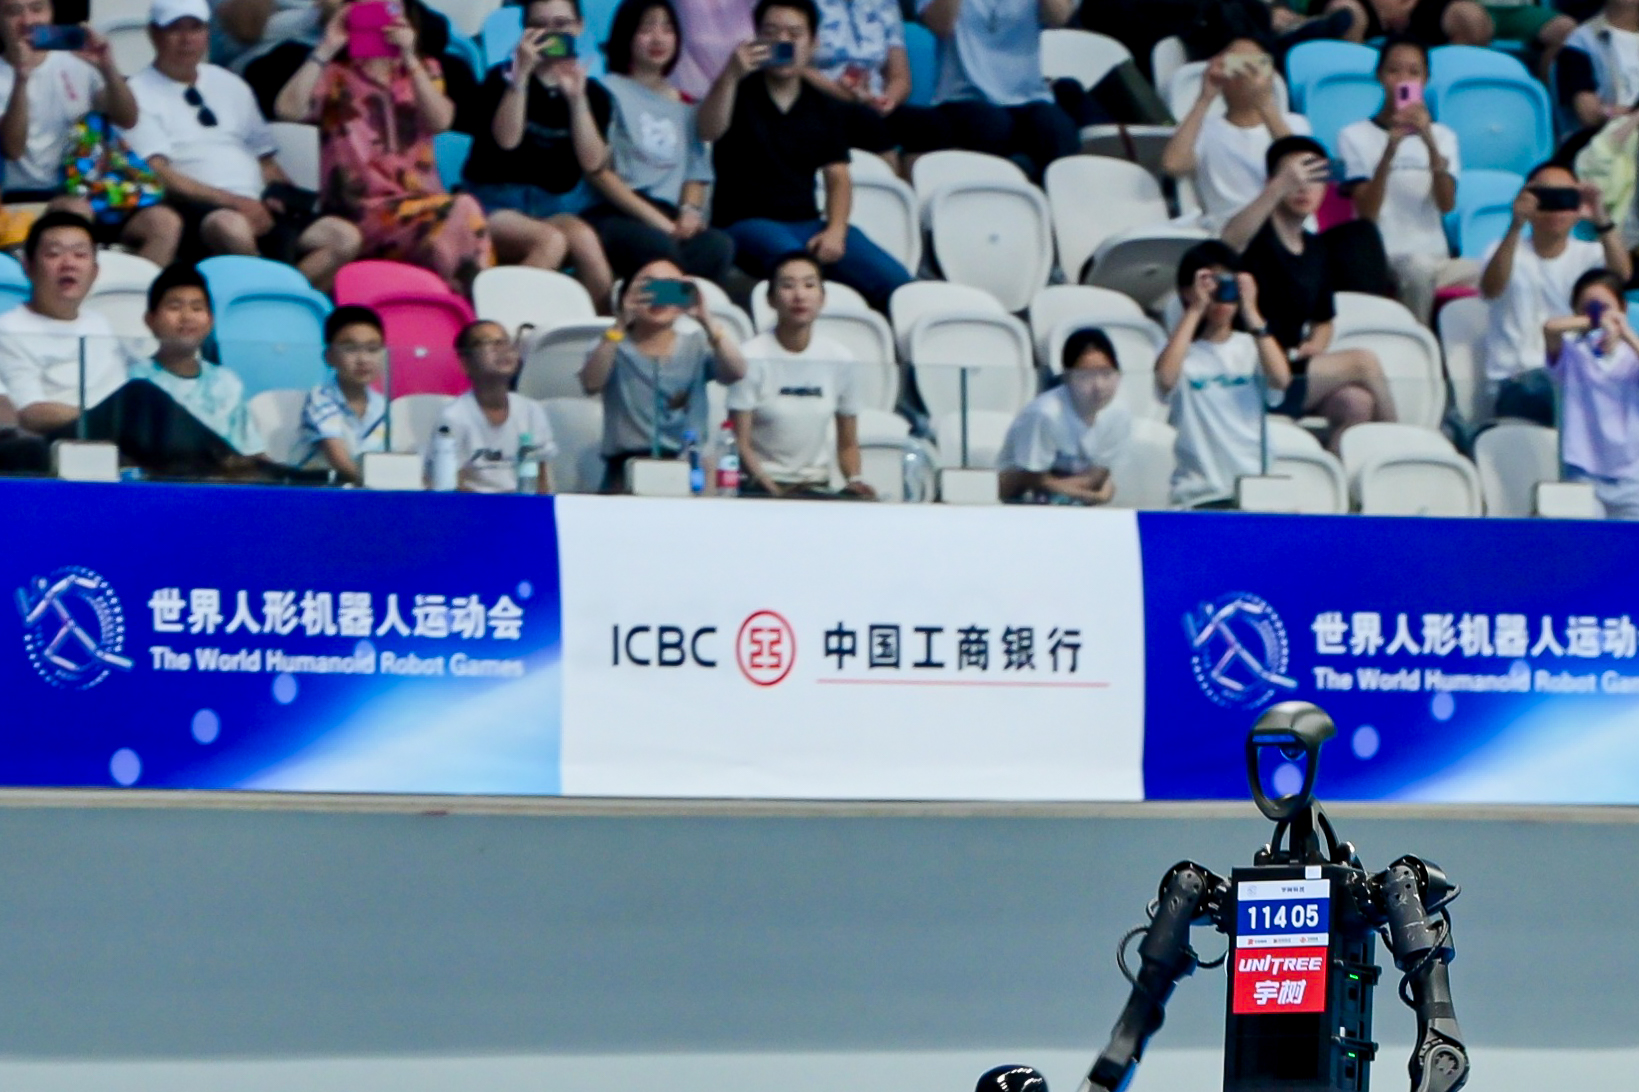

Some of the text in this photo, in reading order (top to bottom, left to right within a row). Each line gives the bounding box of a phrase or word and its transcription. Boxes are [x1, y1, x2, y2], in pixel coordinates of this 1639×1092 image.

[148, 588, 524, 640] 世界人形机器人运动会
[611, 624, 718, 668] ICBC
[823, 621, 1082, 673] 中国工商银行
[150, 646, 524, 679] The World Humanoid Robot Games
[1314, 667, 1353, 690] The
[1358, 668, 1421, 691] World
[1425, 668, 1530, 692] Humanoid
[1535, 670, 1597, 693] Robot
[1247, 904, 1319, 929] 11405
[1238, 954, 1322, 975] UNITREE
[1253, 979, 1307, 1005] 宇树
